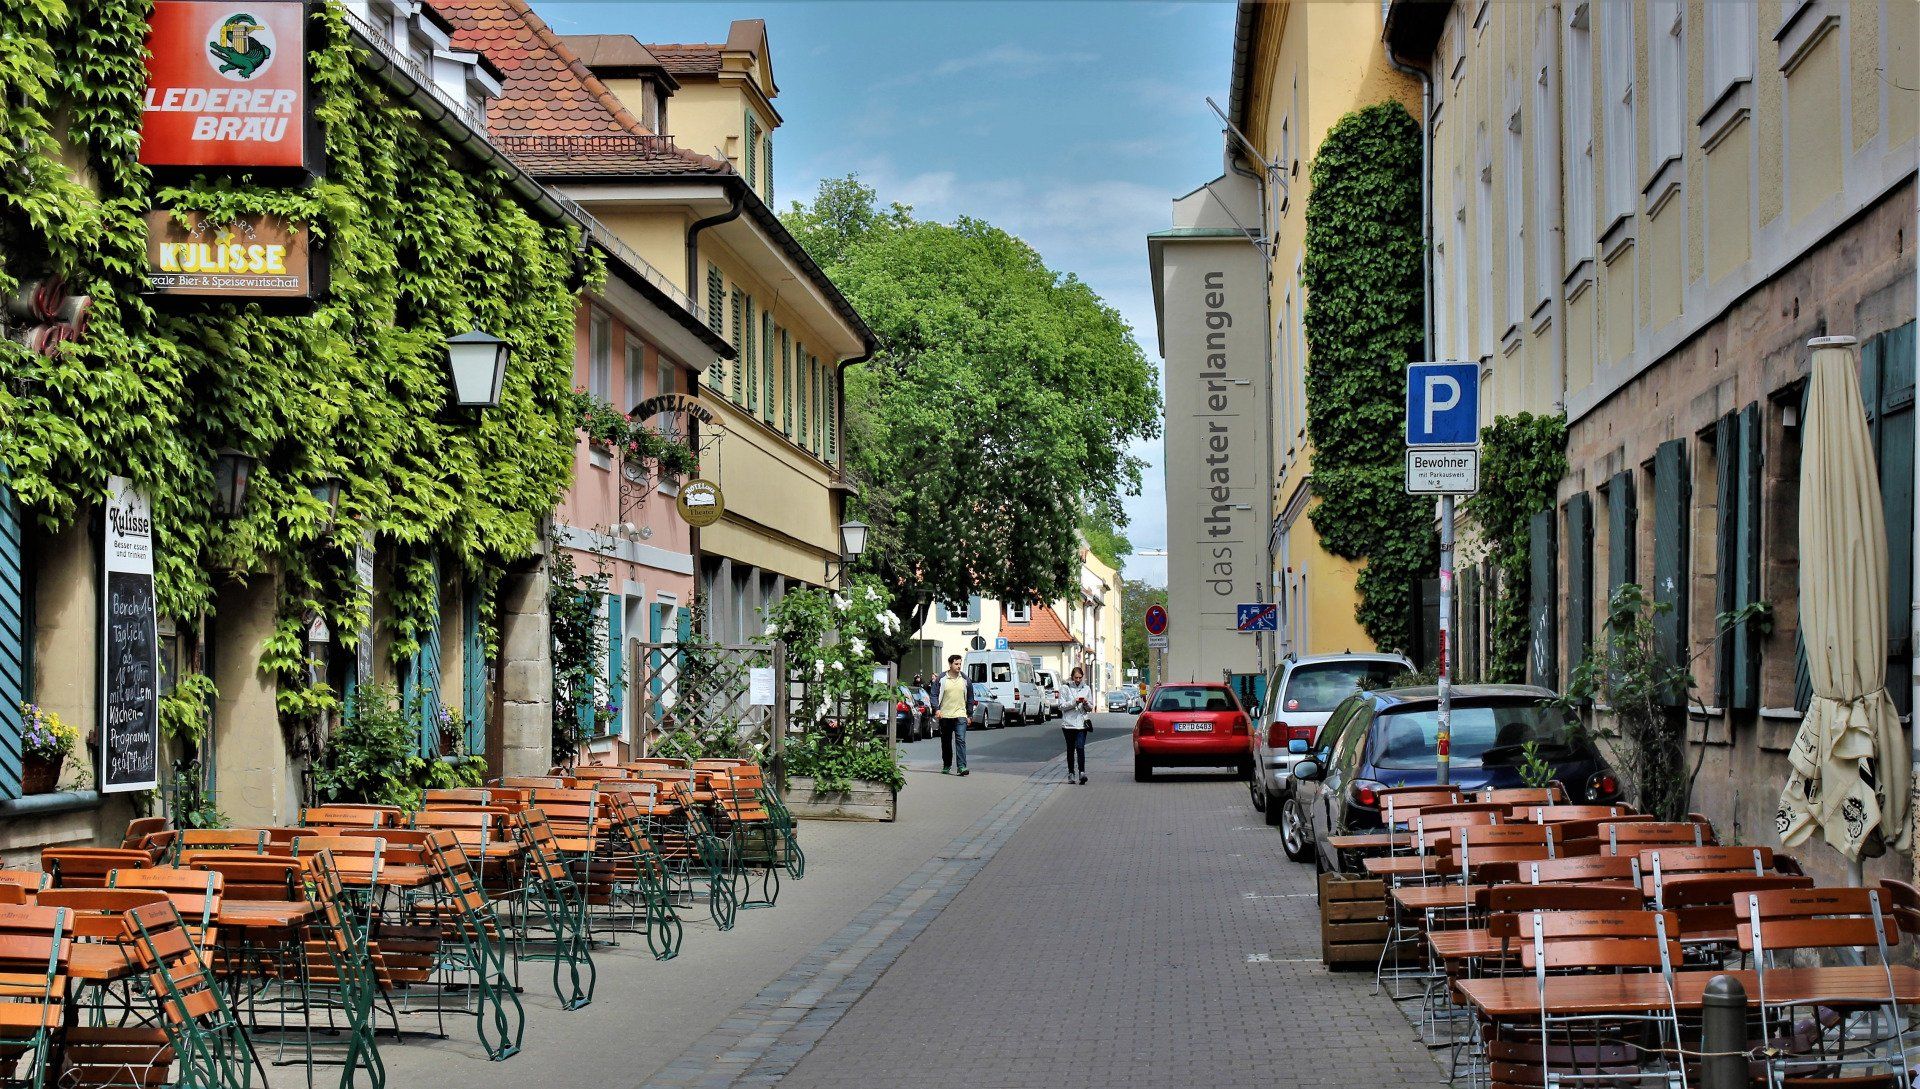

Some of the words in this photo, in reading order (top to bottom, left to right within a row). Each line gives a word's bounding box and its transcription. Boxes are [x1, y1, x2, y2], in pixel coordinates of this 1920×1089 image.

[143, 88, 296, 113] LEDERER
[191, 116, 288, 142] BRÄU
[160, 242, 287, 274] KULISSE
[202, 277, 209, 286] &
[212, 276, 299, 288] Speisewirtschaft
[1199, 271, 1233, 412] erlangen
[1424, 375, 1461, 434] P
[1414, 456, 1469, 468] Bewohner
[1203, 421, 1231, 538] theater
[109, 507, 149, 538] Kulisse
[113, 540, 132, 550] Besser
[133, 543, 148, 551] essen
[1205, 547, 1233, 596] das
